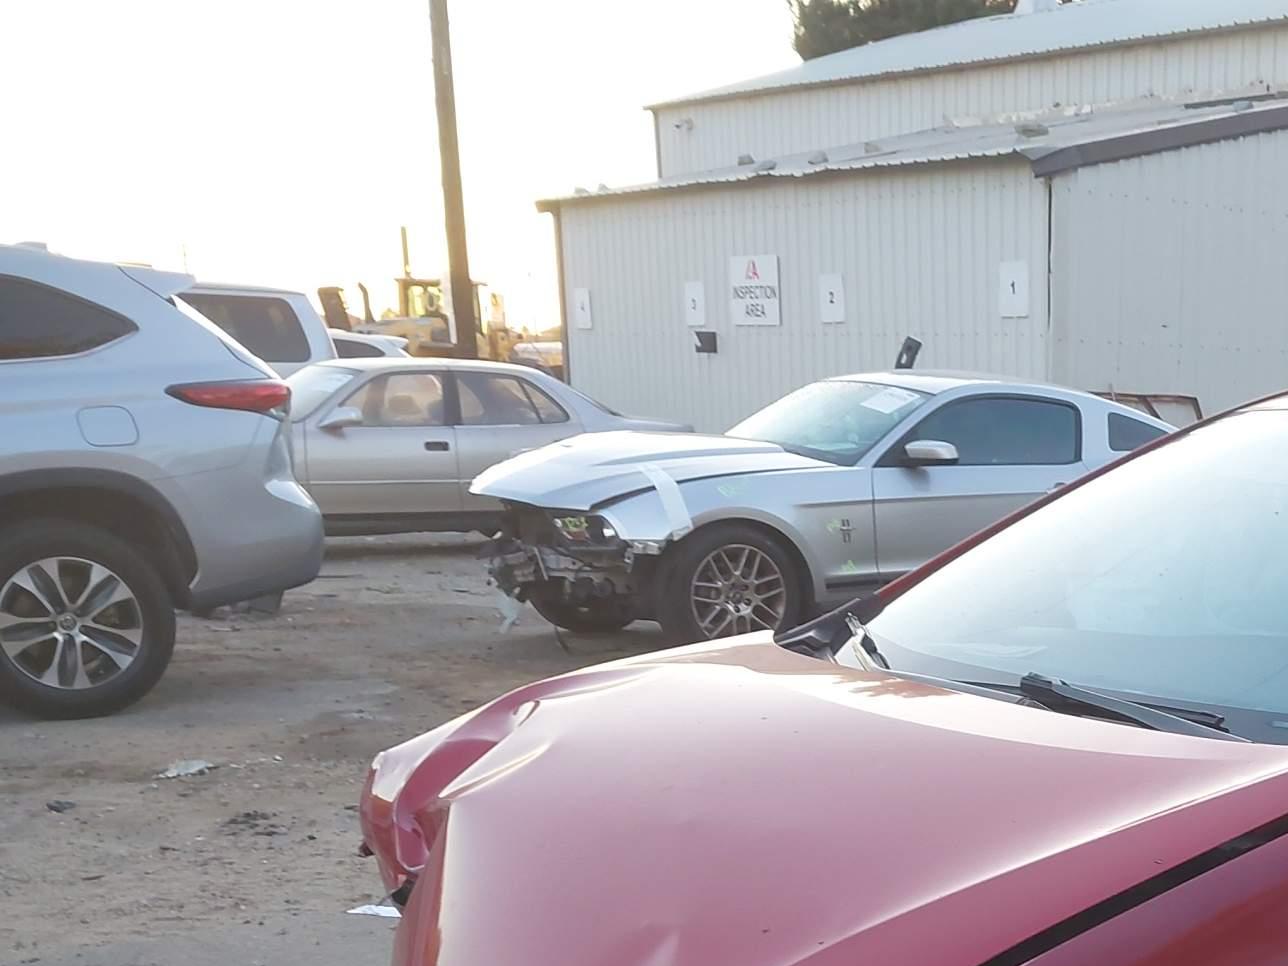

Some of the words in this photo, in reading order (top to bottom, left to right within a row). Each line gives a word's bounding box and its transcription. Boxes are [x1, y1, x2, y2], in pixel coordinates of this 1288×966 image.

[732, 285, 777, 300] INSPECTION
[1010, 280, 1016, 295] 1
[828, 291, 835, 304] 2
[745, 303, 767, 318] AREA
